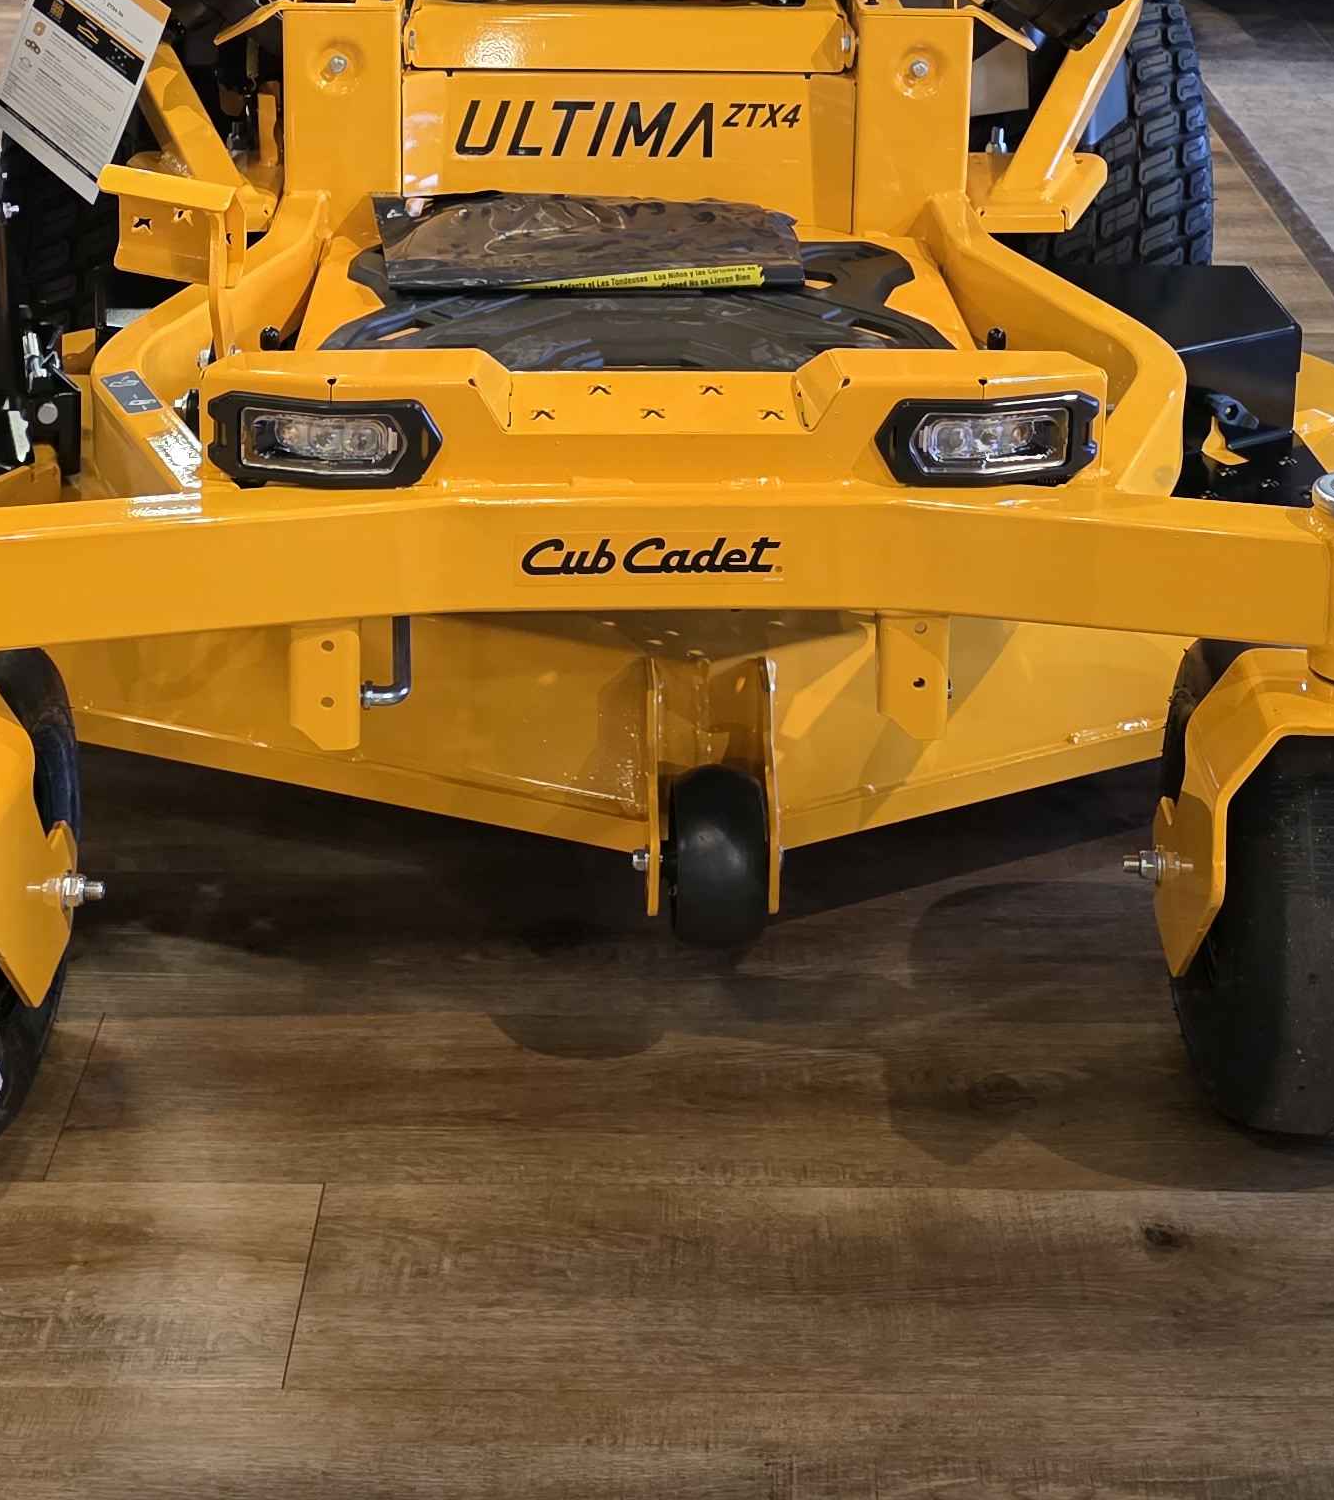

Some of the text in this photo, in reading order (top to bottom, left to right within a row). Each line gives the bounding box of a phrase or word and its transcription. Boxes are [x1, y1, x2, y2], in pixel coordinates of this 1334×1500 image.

[454, 100, 802, 158] ULTIMA ZTX4
[653, 273, 666, 281] Los
[735, 274, 751, 282] Bien
[597, 279, 610, 288] Les
[521, 536, 782, 575] Cub Cadet
